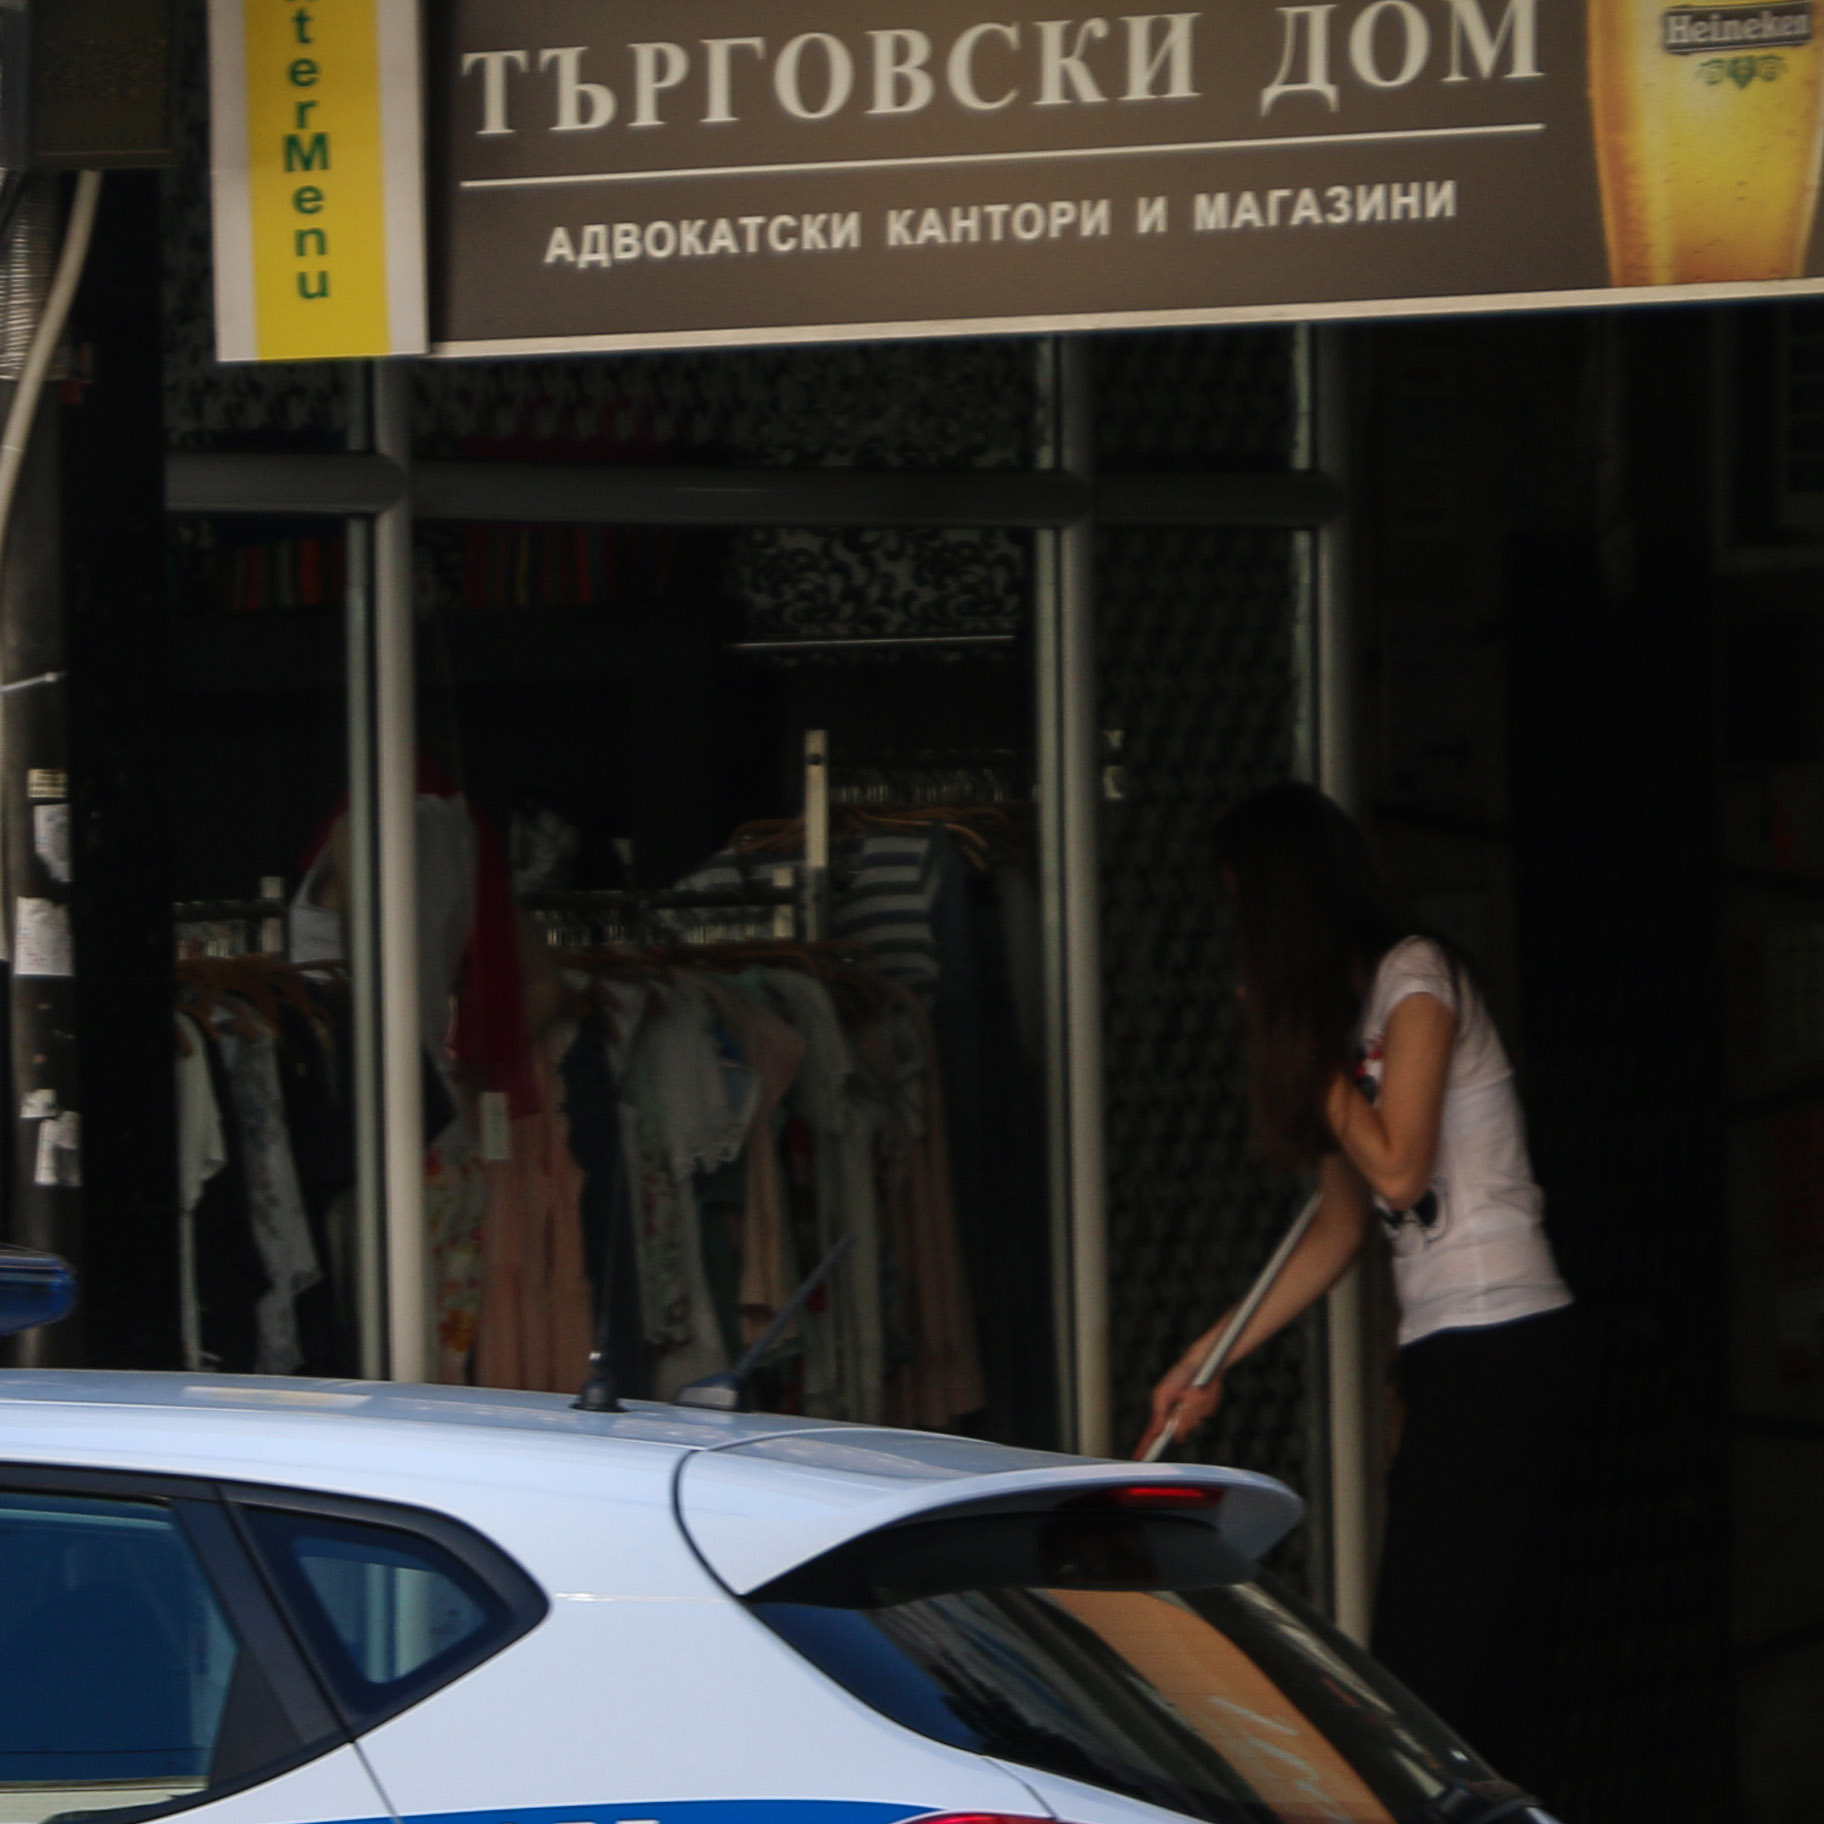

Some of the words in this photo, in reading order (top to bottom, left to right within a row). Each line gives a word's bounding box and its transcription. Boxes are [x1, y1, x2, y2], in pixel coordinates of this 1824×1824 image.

[461, 12, 1203, 135] ТЪРГОВСКИ
[1259, 0, 1545, 117] ДОМ
[1665, 9, 1811, 45] Heineken
[282, 0, 331, 300] terMenu
[543, 210, 863, 270] АДВОКАТСКИ
[887, 199, 1111, 247] КАНТОРИ
[1136, 196, 1169, 235] И
[1193, 179, 1458, 232] МАГАЗИНИ
